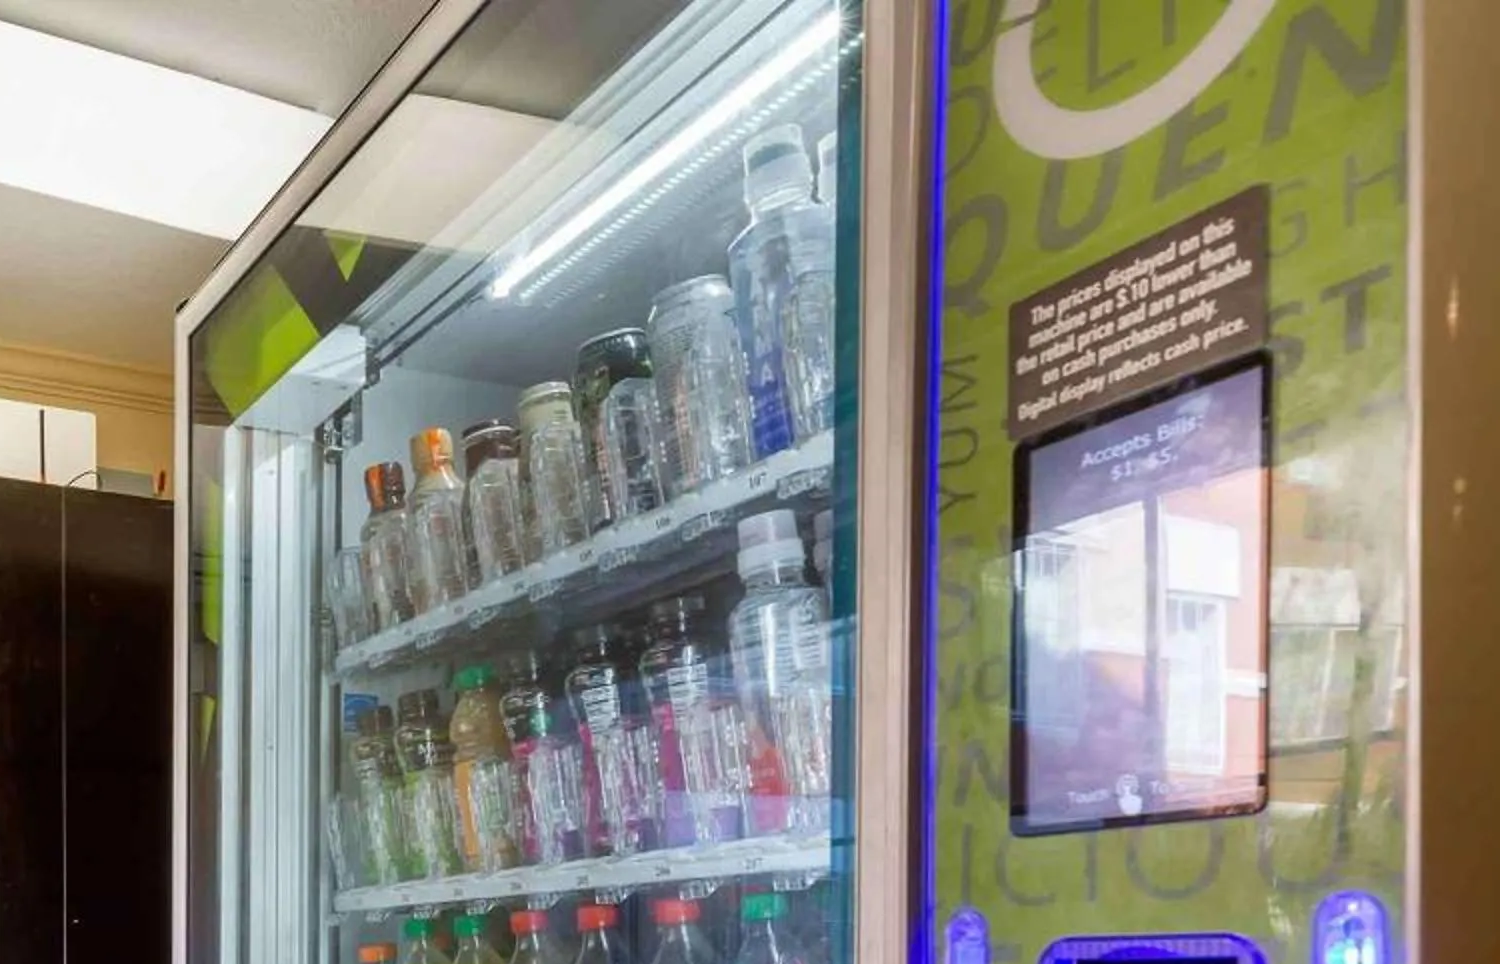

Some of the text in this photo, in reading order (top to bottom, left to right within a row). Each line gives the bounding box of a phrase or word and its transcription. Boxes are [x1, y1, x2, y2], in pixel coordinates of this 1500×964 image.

[1017, 257, 1252, 375] the retail price and are available
[1029, 310, 1086, 348] machine
[1090, 299, 1113, 321] are
[1151, 259, 1196, 292] lower
[1199, 242, 1237, 270] than
[1031, 217, 1235, 325] The prices displayed on this
[1018, 317, 1249, 422] Digital display reflects cash price.
[1042, 299, 1219, 385] on cash purchases only.
[1081, 433, 1152, 468] Accepts
